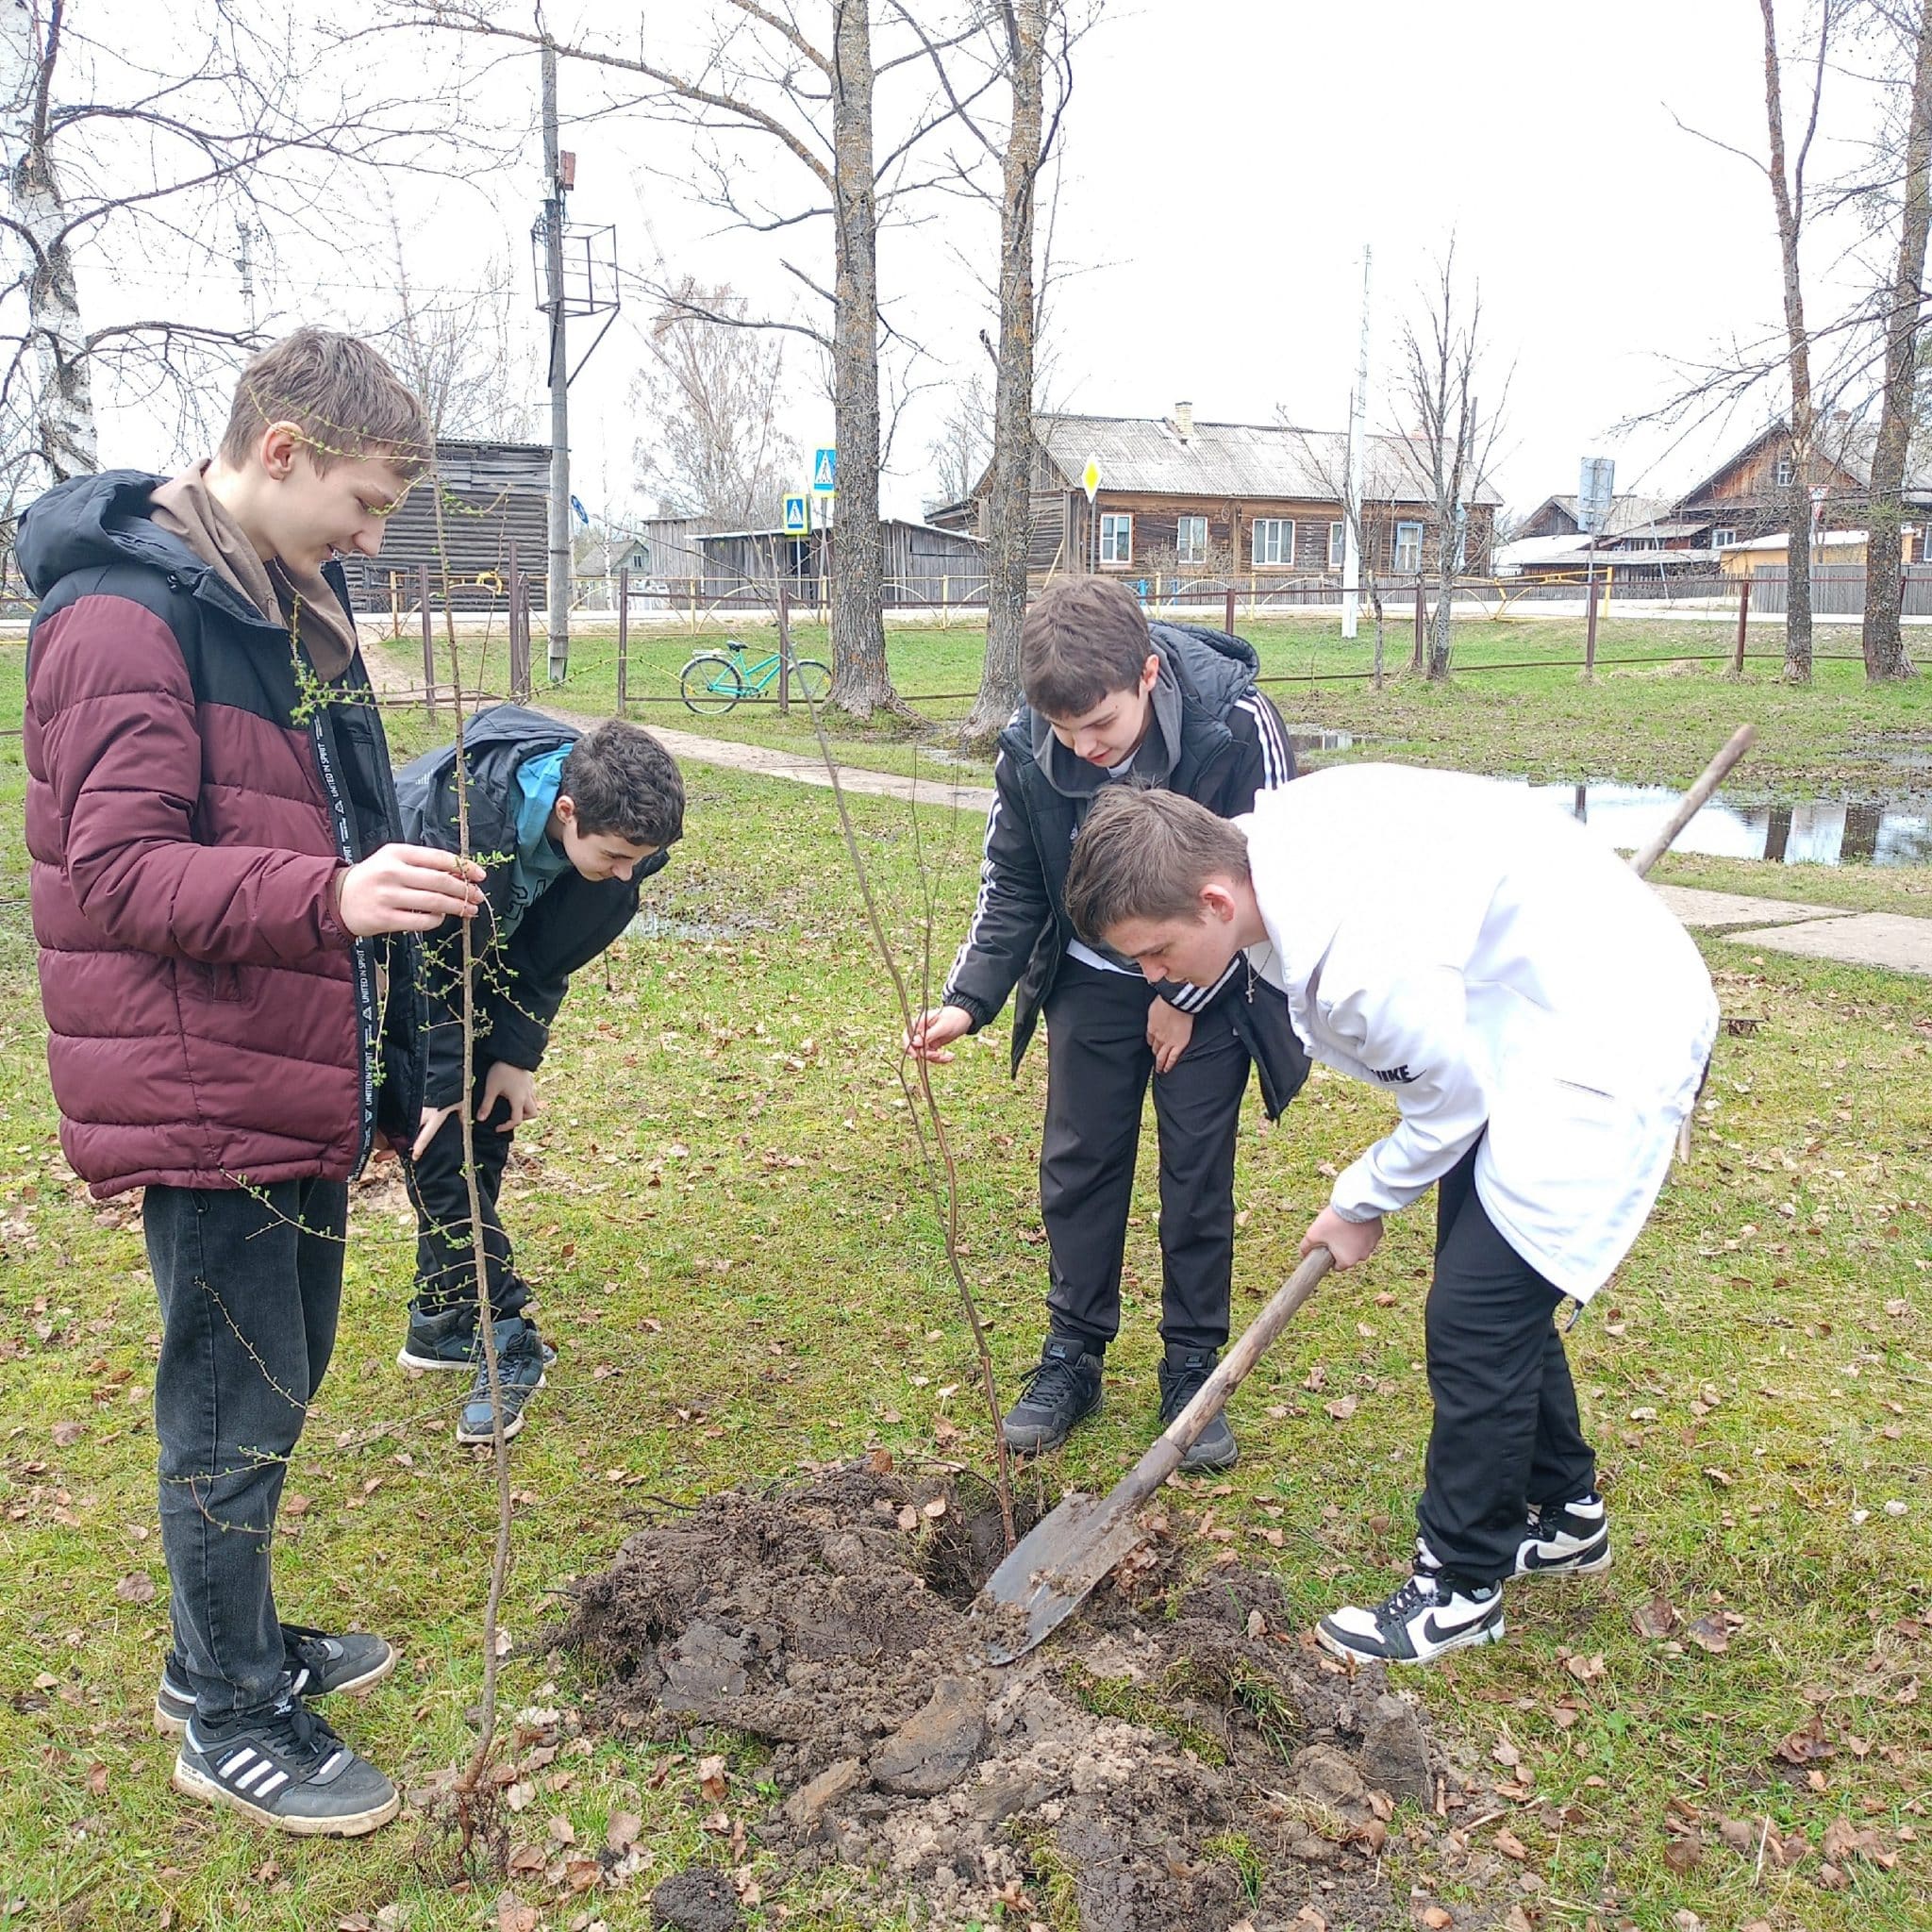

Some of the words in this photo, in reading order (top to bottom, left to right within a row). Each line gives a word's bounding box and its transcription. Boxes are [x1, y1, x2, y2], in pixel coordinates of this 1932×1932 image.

[322, 764, 331, 773] IN
[325, 773, 340, 798] UNITED
[356, 949, 367, 970] SPIRIT
[360, 977, 371, 1004] UNITED
[365, 1079, 374, 1106] UNITED
